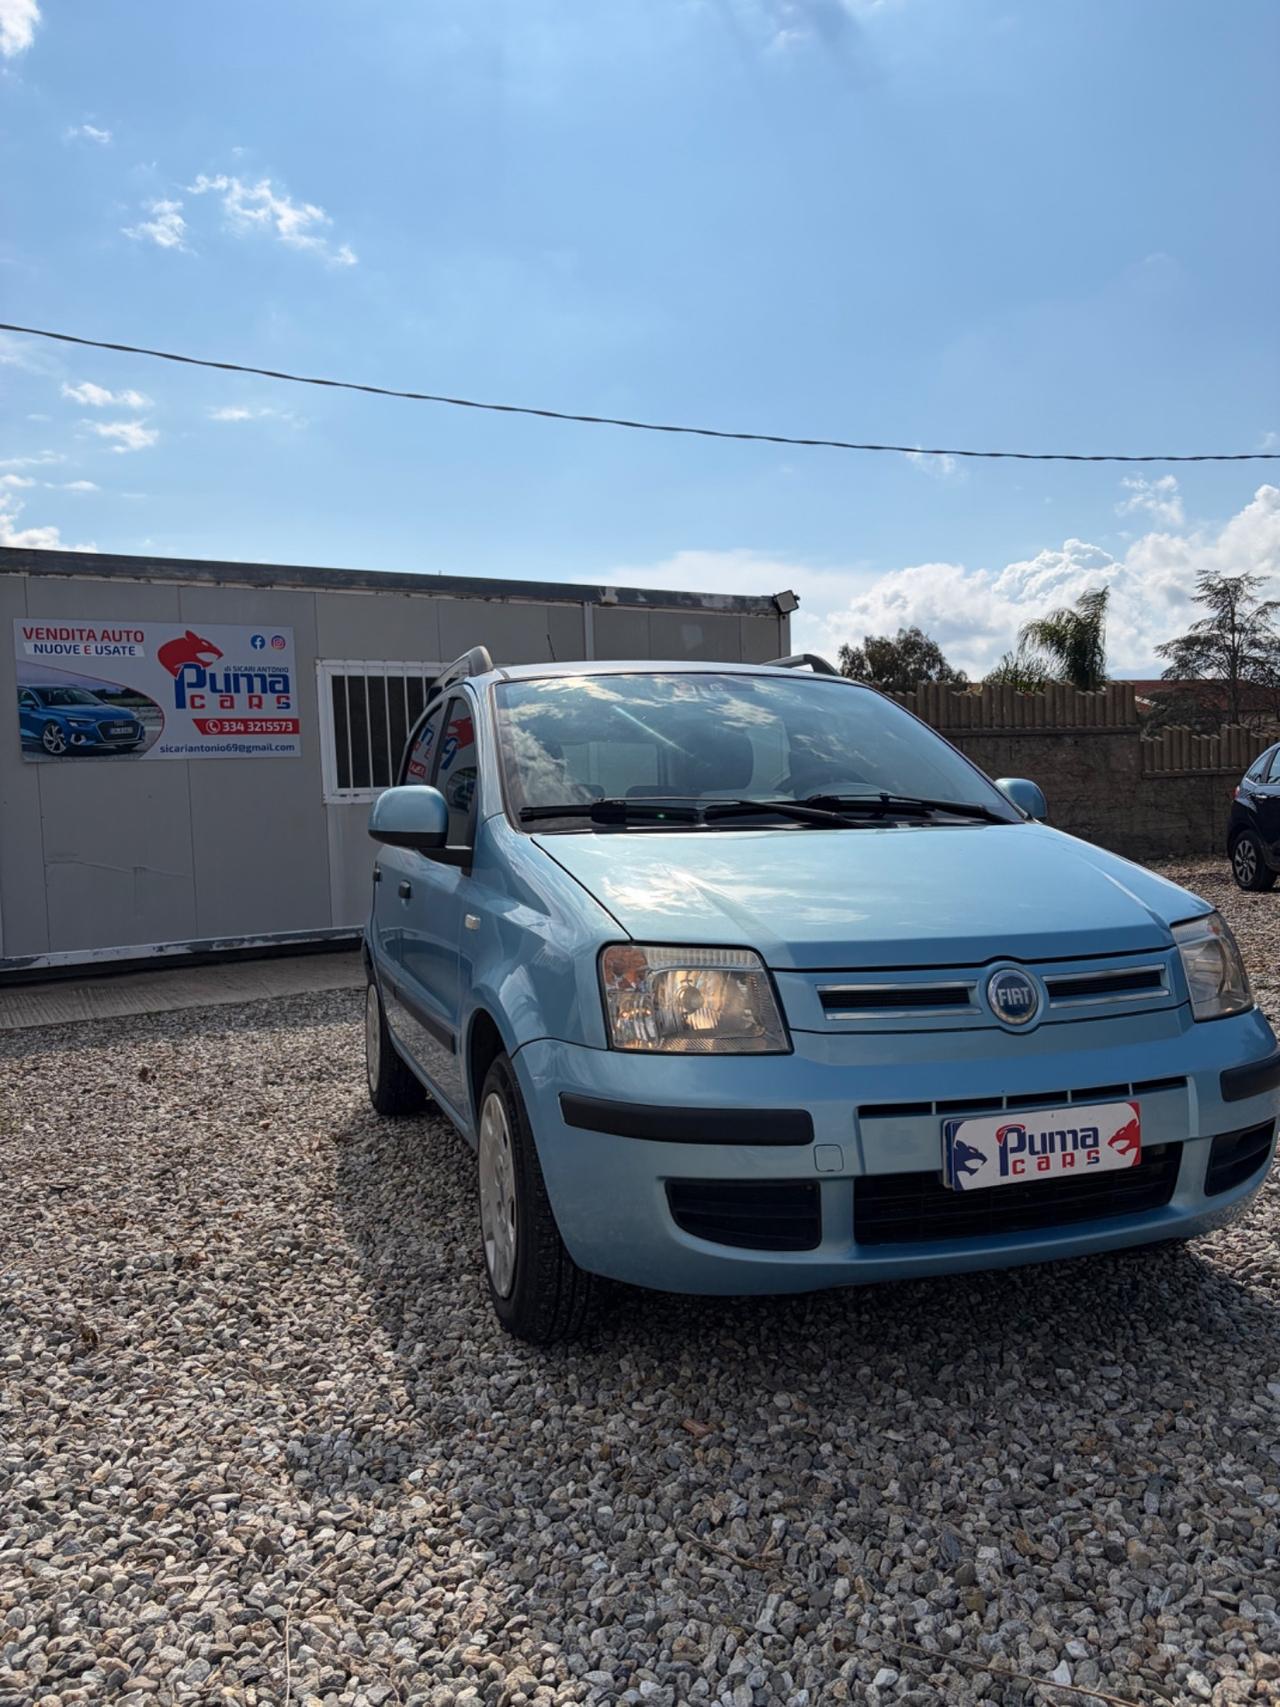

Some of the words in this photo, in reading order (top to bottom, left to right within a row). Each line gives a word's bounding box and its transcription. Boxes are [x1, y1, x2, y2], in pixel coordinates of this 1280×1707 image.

[22, 627, 97, 642] VENDITA
[101, 629, 145, 643] AUTO
[33, 643, 81, 655] NUOVE
[84, 644, 92, 655] E
[95, 645, 136, 656] USATE
[233, 665, 256, 673] SICARI
[174, 663, 290, 709] Puma
[222, 721, 245, 732] 334
[247, 721, 293, 732] 3215573
[160, 743, 295, 754] sicariantonio69@gmail.com
[997, 986, 1031, 1007] FIAT
[999, 1126, 1099, 1176] Puma
